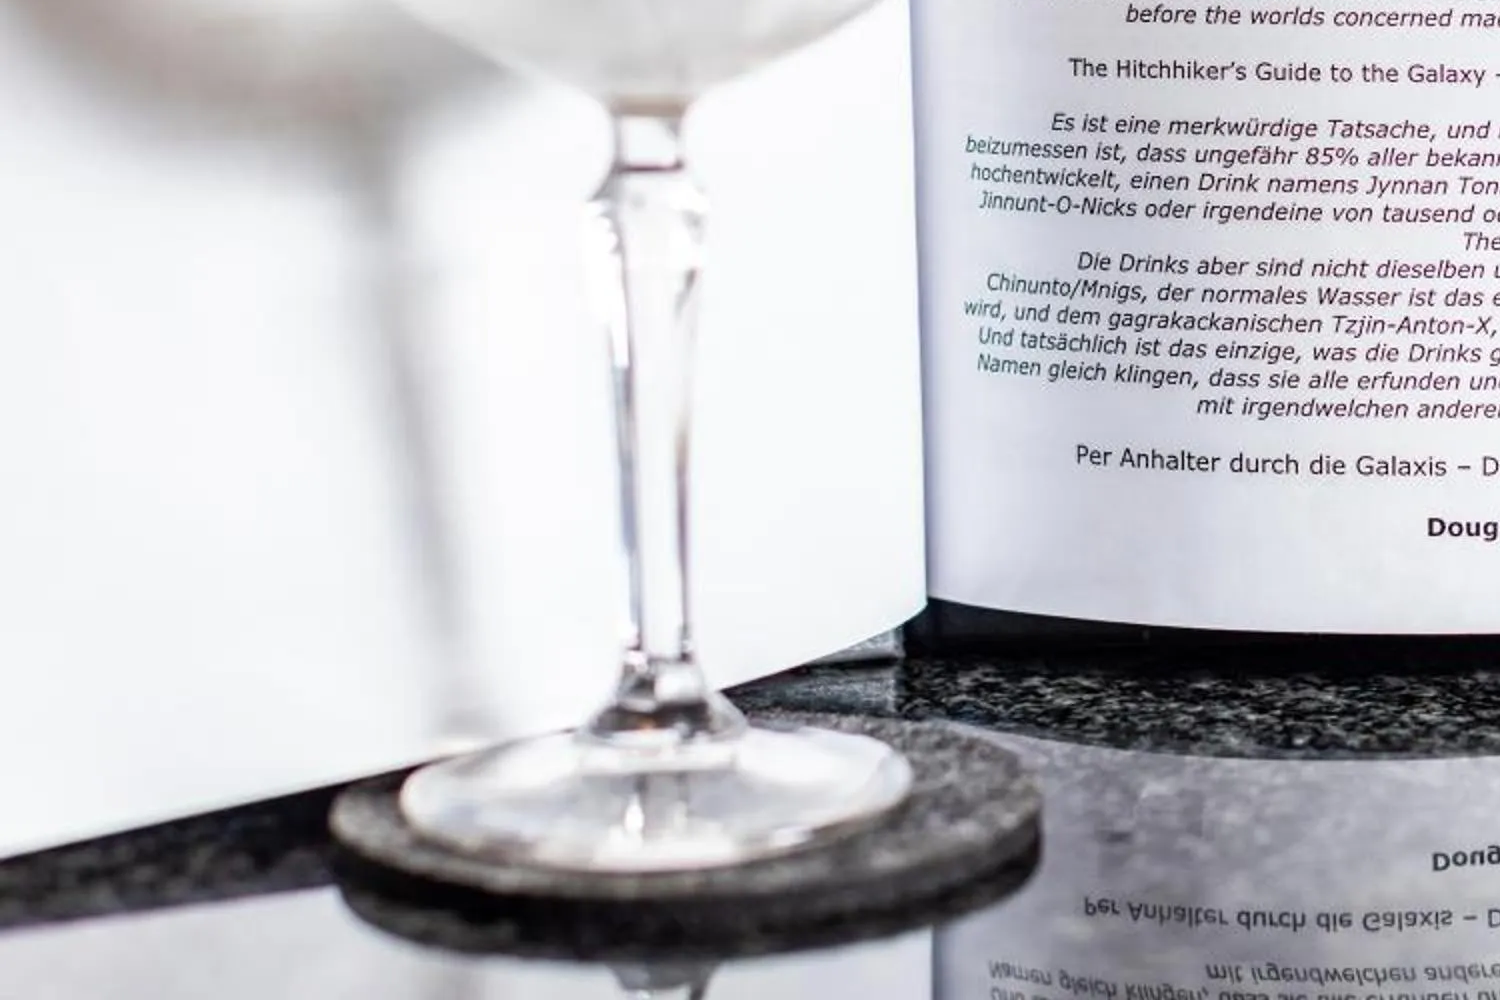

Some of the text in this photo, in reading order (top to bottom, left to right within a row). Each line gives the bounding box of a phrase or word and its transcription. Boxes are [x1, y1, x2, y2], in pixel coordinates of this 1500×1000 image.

[1125, 2, 1197, 25] before
[1205, 4, 1242, 26] the
[1250, 5, 1326, 27] worlds
[1332, 7, 1454, 28] concerned
[1067, 57, 1108, 79] The
[1254, 61, 1322, 83] Guide
[1329, 63, 1354, 84] to
[1360, 63, 1400, 84] the
[1406, 63, 1487, 89] Galaxy
[1050, 111, 1076, 133] Es
[1081, 113, 1110, 133] ist
[1114, 114, 1162, 136] eine
[1167, 115, 1319, 143] merkwürdige
[1327, 118, 1437, 144] Tatsache,
[1446, 119, 1492, 140] und
[978, 189, 1139, 218] Jinnunt-O-Nicks
[1144, 198, 1197, 220] oder
[1202, 200, 1324, 225] irgendeine
[1332, 206, 1374, 224] von
[1382, 203, 1476, 224] tausend
[963, 299, 1007, 323] wird,
[1013, 303, 1051, 323] und
[1055, 305, 1101, 326] dem
[1107, 309, 1324, 334] gagrakackanischen
[1331, 314, 1498, 339] Tzjin-Anton-X,
[1196, 395, 1236, 416] mit
[1241, 396, 1410, 422] irgendwelchen
[1076, 443, 1113, 467] Per
[1119, 446, 1222, 473] Anhalter
[1228, 451, 1300, 476] durch
[1308, 452, 1347, 476] die
[1355, 454, 1448, 478] Galaxis
